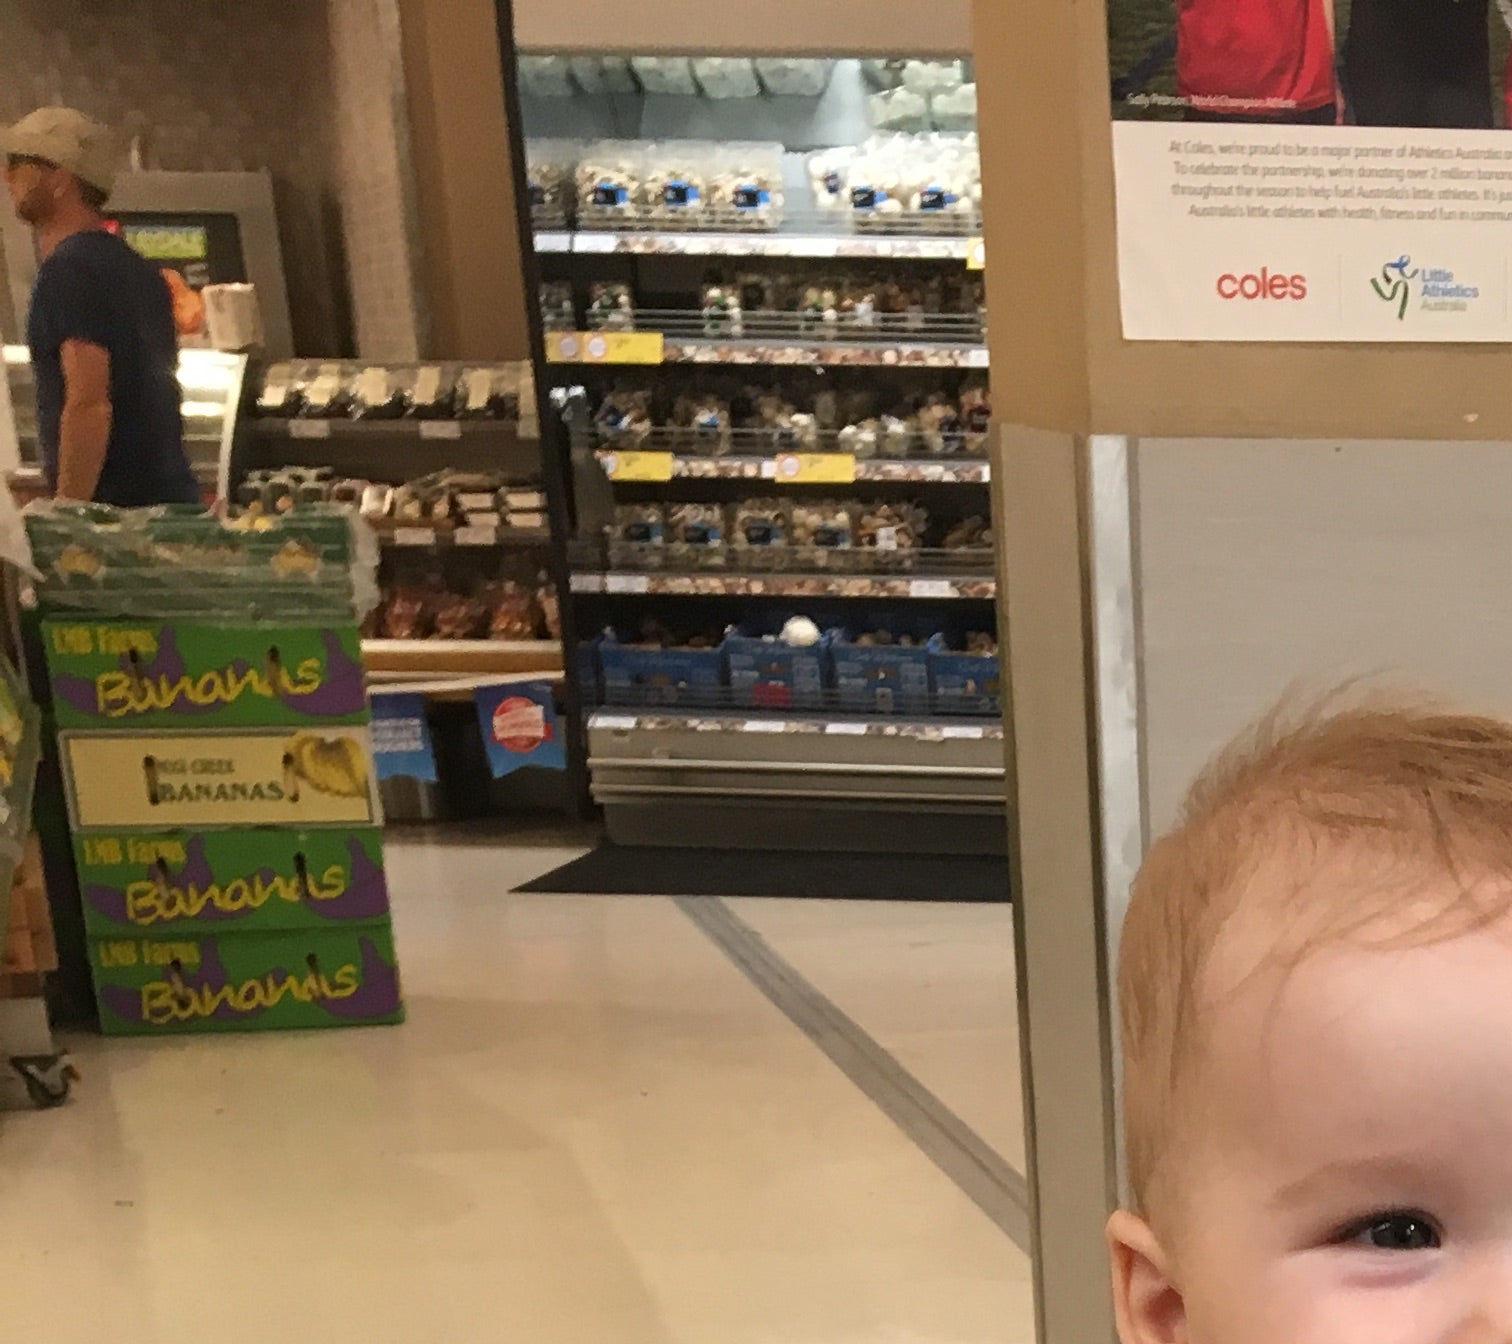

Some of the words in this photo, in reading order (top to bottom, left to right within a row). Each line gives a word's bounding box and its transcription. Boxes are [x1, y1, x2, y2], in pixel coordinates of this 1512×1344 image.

[1421, 268, 1454, 282] Little
[1217, 267, 1307, 301] coles
[1421, 284, 1479, 298] Athletics
[1420, 299, 1468, 312] Australia
[159, 781, 285, 802] BANANAS
